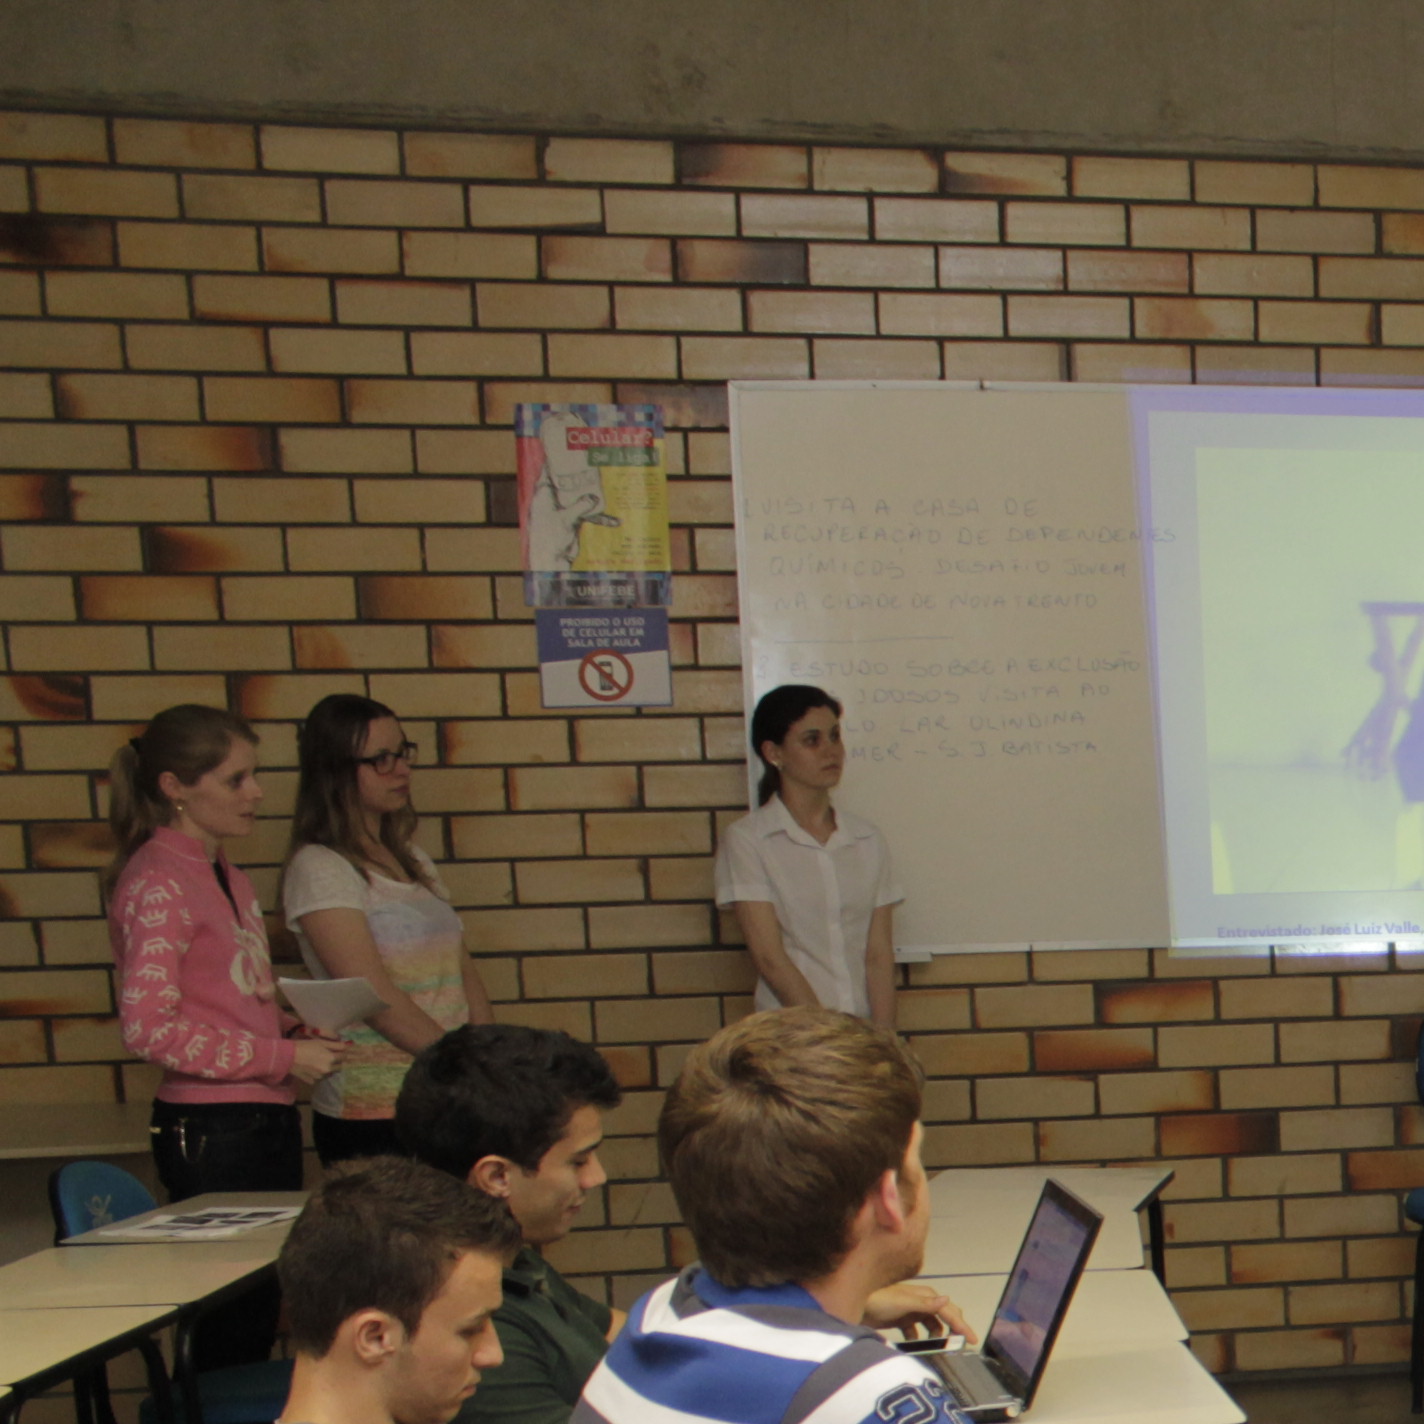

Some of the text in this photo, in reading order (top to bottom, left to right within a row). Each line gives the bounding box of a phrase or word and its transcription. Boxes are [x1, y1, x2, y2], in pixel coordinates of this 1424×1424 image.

[568, 430, 653, 445] Celular?
[761, 498, 856, 516] VISITA
[875, 499, 890, 515] A
[914, 498, 981, 518] CASA
[1005, 498, 1037, 517] DE
[957, 527, 990, 546] DE
[936, 560, 1049, 575] DESAFIO
[1063, 560, 1126, 578] JOVEM
[577, 585, 635, 597] UNIFEBE
[821, 593, 901, 610] CIDADE
[911, 594, 936, 609] DE
[560, 616, 645, 627] PROIBIDO O USO
[562, 627, 644, 638] DE CELULAR EM
[567, 637, 641, 648] SALA DE AULA
[790, 660, 889, 678] ESTUDO
[906, 658, 996, 678] SOBRE
[899, 716, 950, 734] LAR
[1001, 741, 1098, 756] BATISTA
[1216, 923, 1316, 939] Entrevistado:
[1319, 922, 1351, 936] José
[1354, 923, 1381, 935] Luiz
[1385, 920, 1424, 934] Valle,
